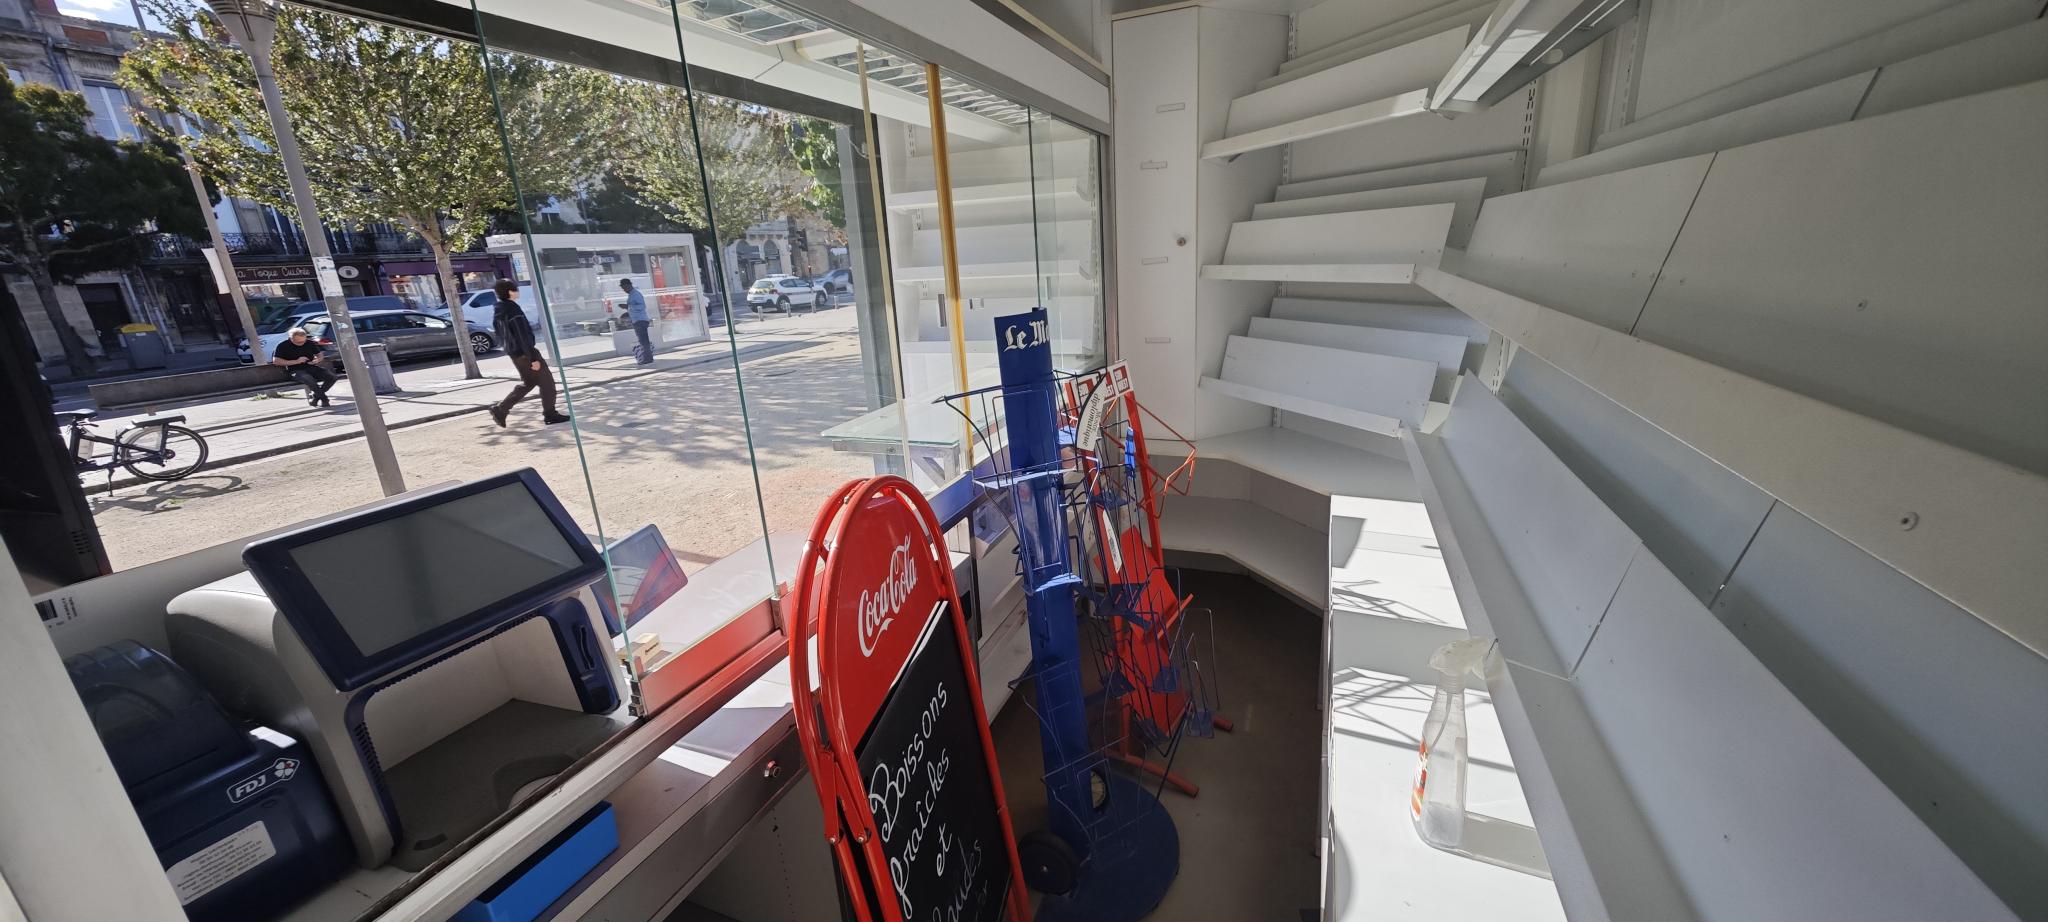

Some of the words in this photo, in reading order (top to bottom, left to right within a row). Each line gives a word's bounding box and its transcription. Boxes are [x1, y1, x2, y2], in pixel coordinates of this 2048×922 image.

[1003, 325, 1028, 352] Le
[1083, 393, 1100, 447] diplomatique
[858, 532, 917, 657] Coca-Cola
[235, 775, 267, 798] FDJ
[868, 682, 947, 842] Boissons
[890, 748, 949, 919] fraîches
[936, 823, 952, 876] et
[932, 836, 982, 922] audes
